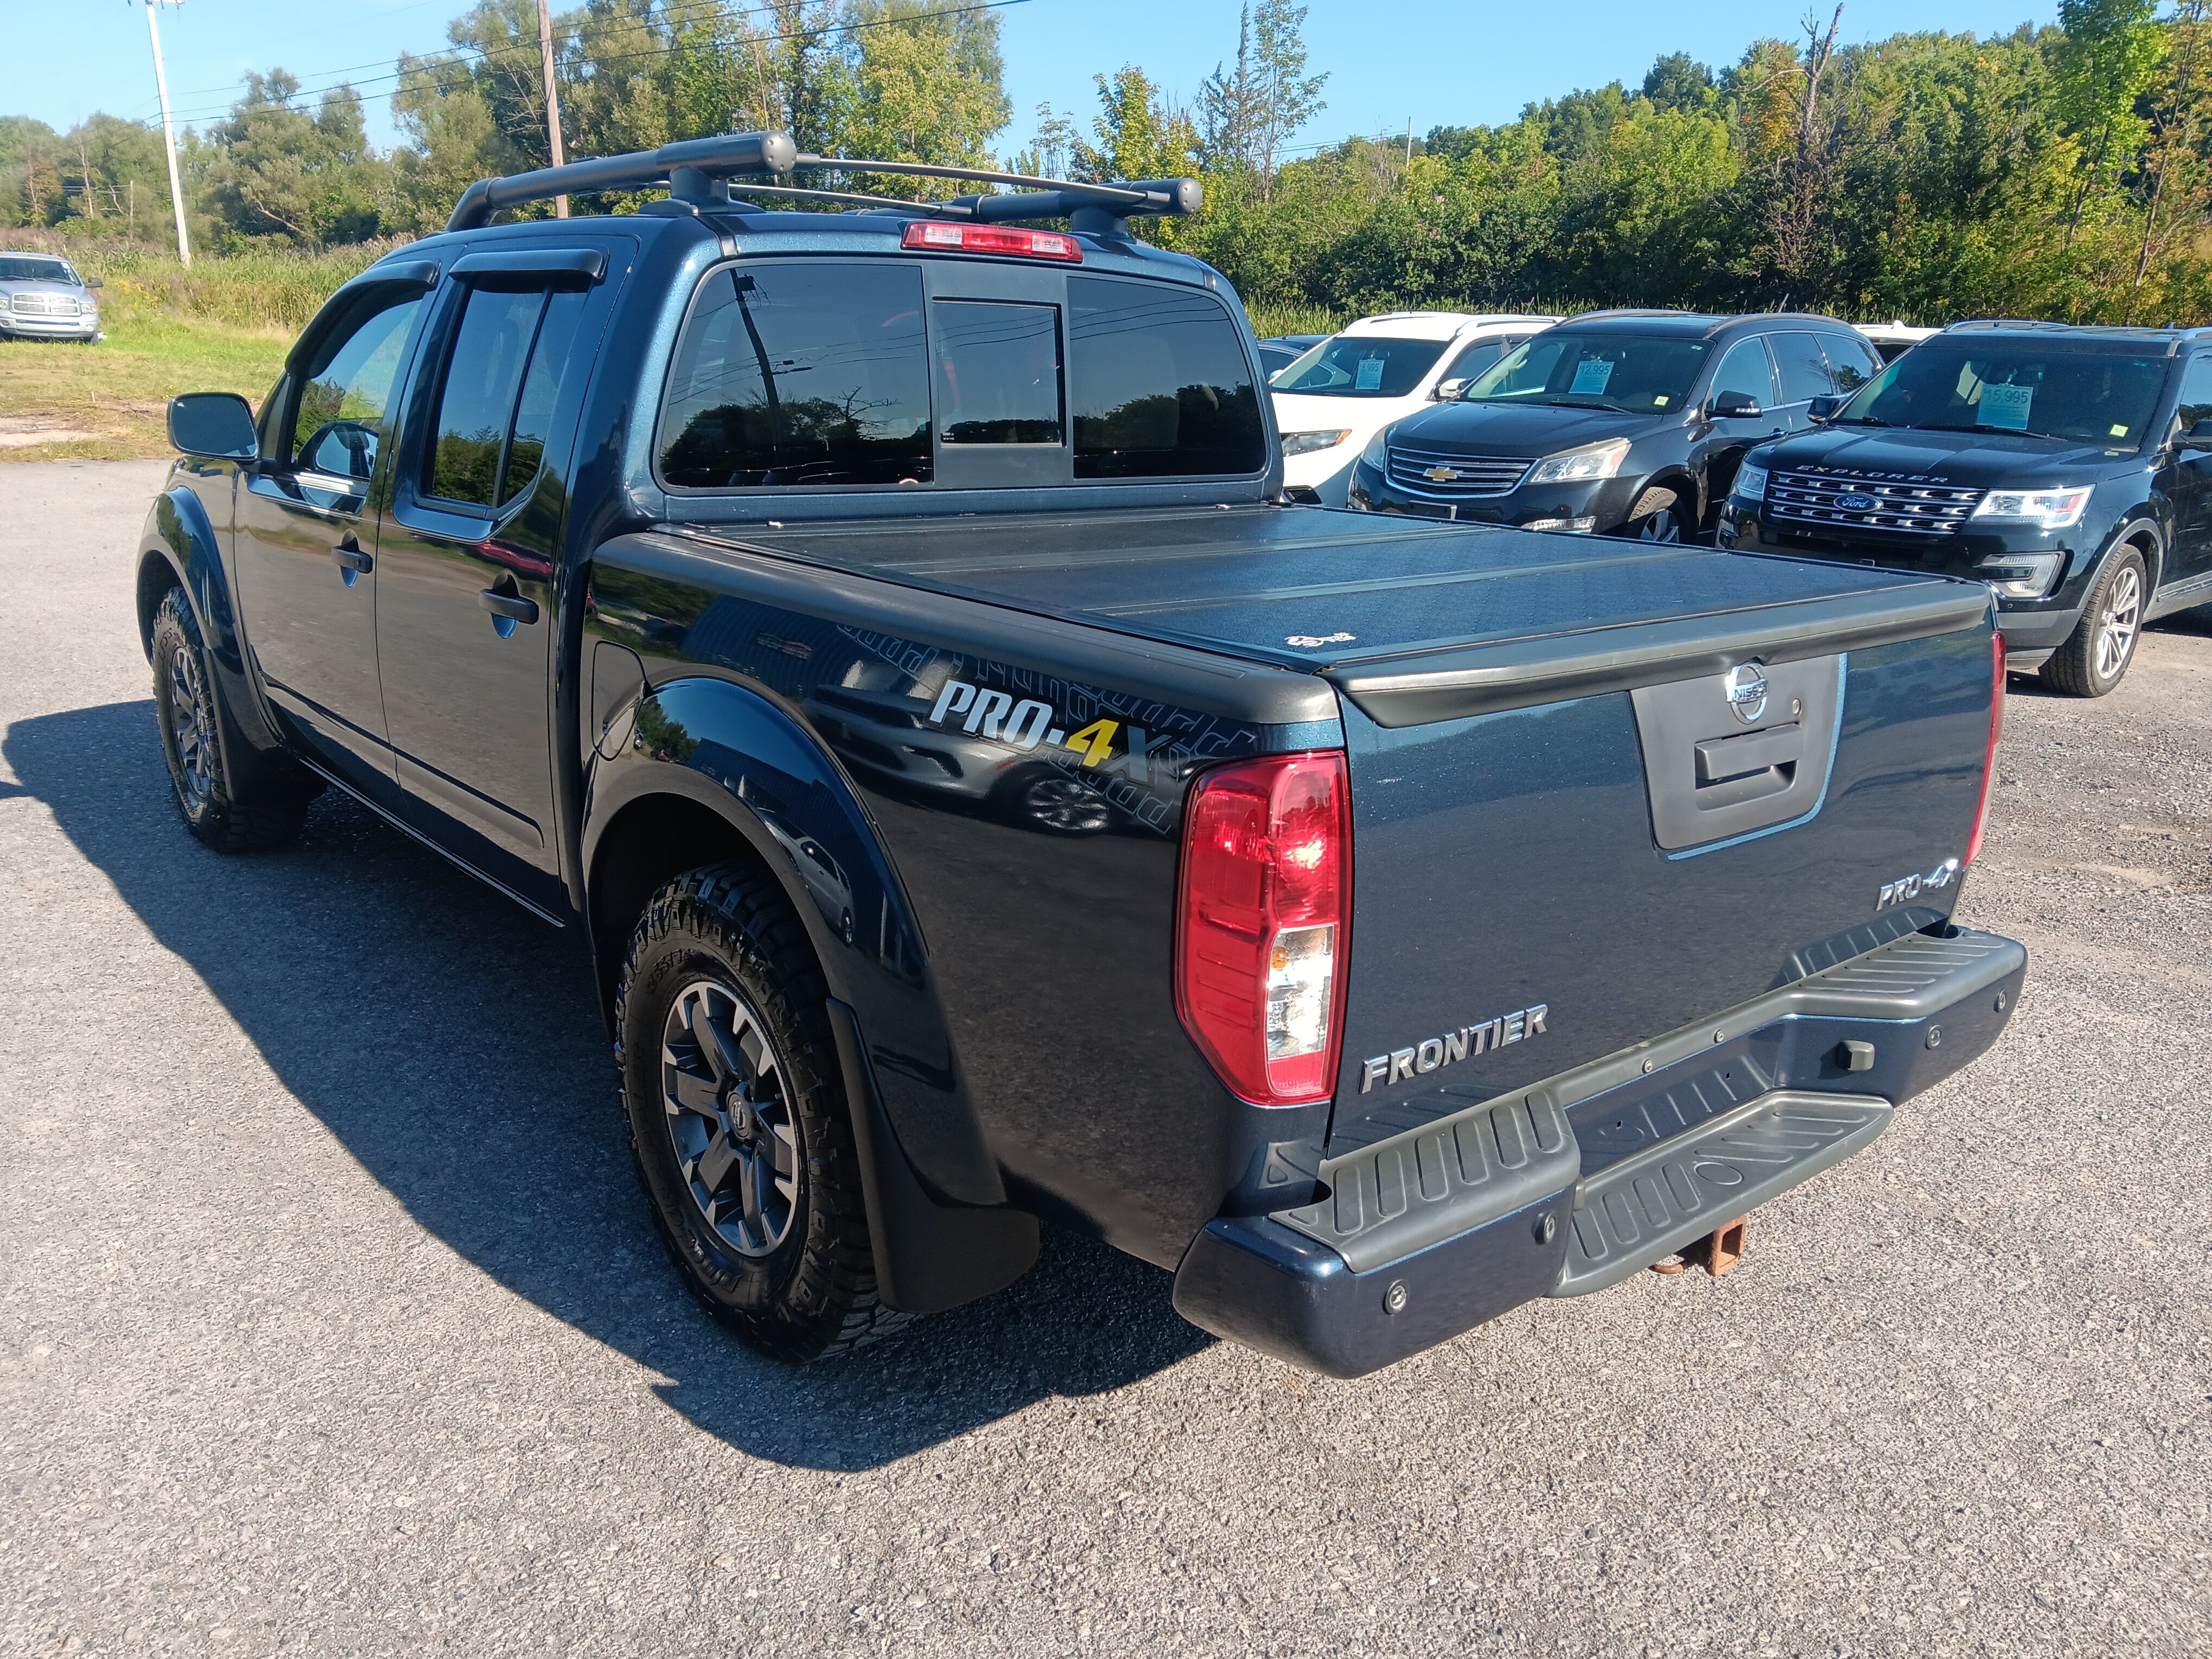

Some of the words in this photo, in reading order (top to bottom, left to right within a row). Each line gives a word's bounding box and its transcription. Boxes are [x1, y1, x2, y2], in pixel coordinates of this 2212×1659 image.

[1580, 365, 1610, 376] 12,995
[1984, 389, 2028, 403] 15,995
[1796, 465, 1948, 483] EXPLORER
[1842, 496, 1869, 509] Ford
[1734, 681, 1768, 699] NISS
[1359, 1004, 1548, 1094] FRONTIER
